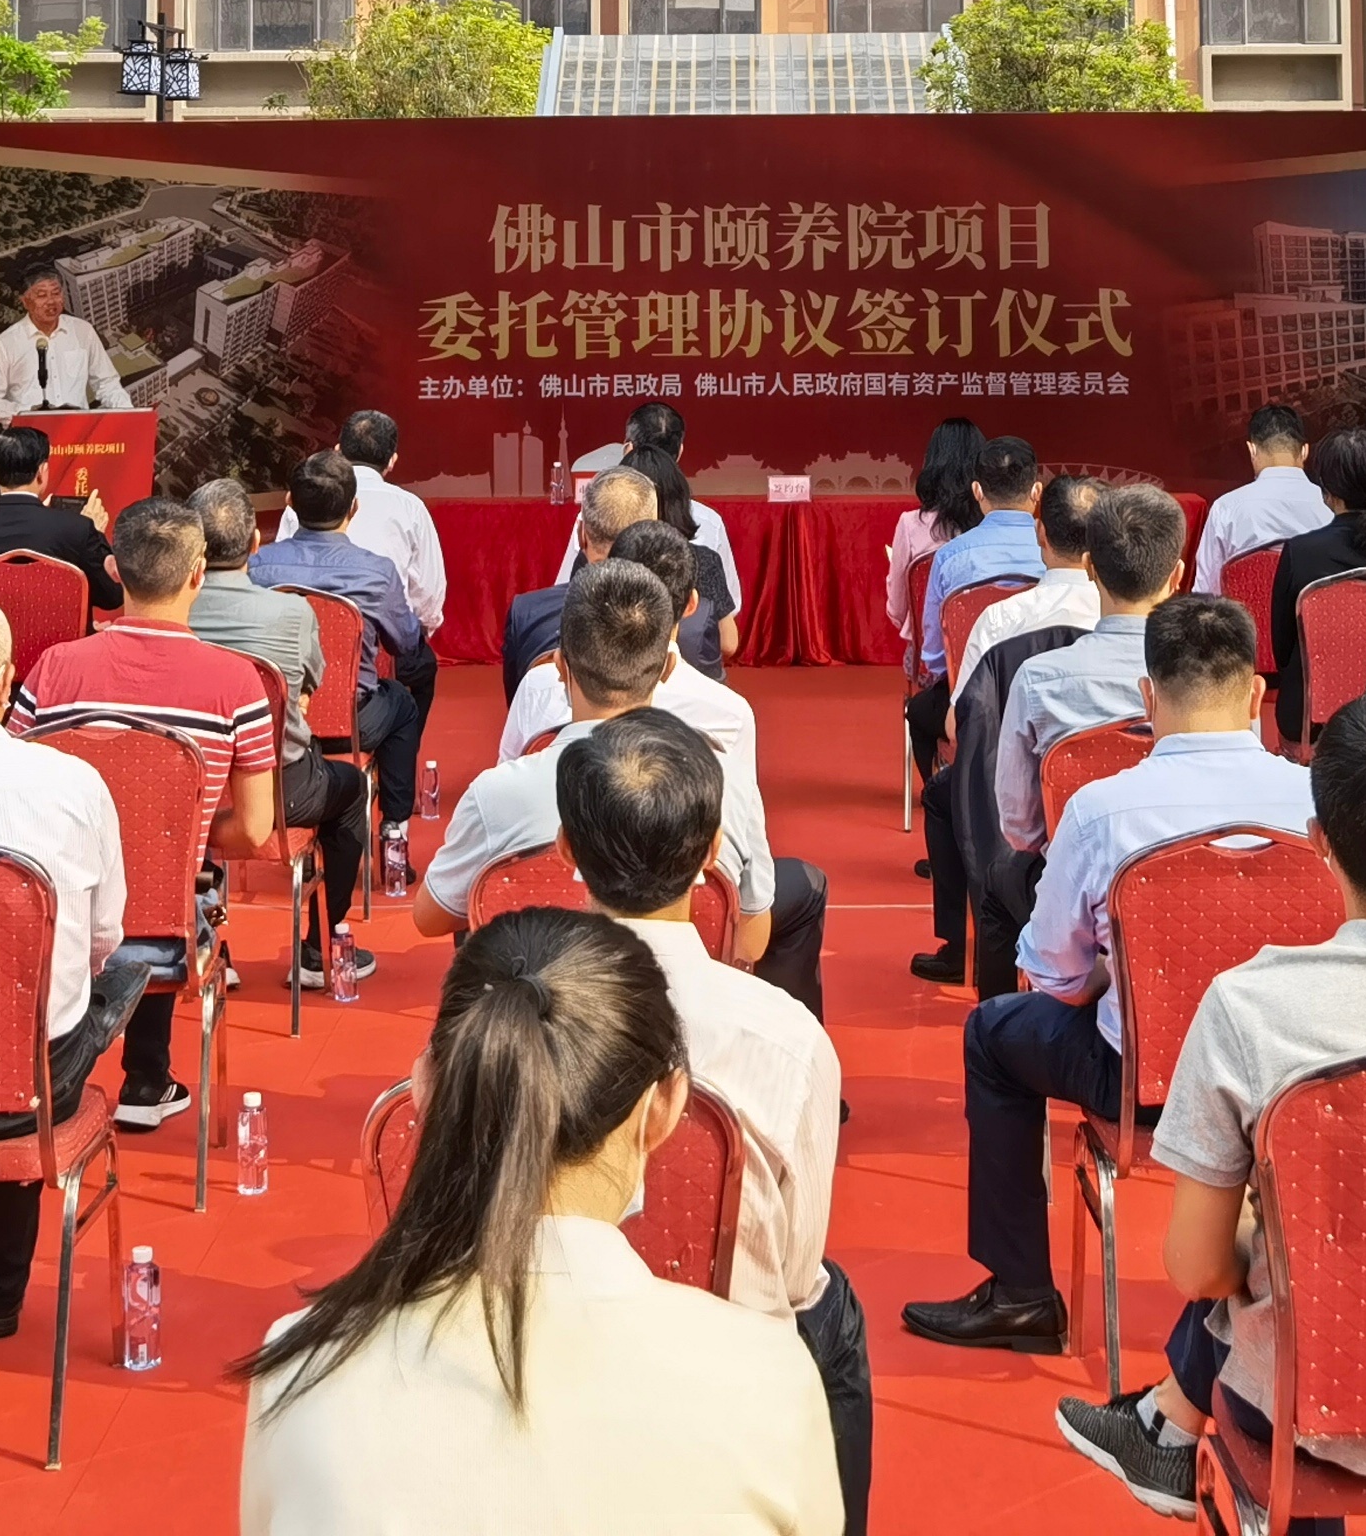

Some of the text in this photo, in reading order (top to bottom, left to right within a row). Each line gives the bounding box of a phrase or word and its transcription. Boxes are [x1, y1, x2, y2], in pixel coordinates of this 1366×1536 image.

[488, 201, 1050, 273] 佛山市颐养院项目
[418, 287, 1133, 360] 委托管理协议签订仪式
[694, 369, 1130, 399] 佛山市人民政府国有资产监督管理委员会
[74, 467, 89, 496] 委托
